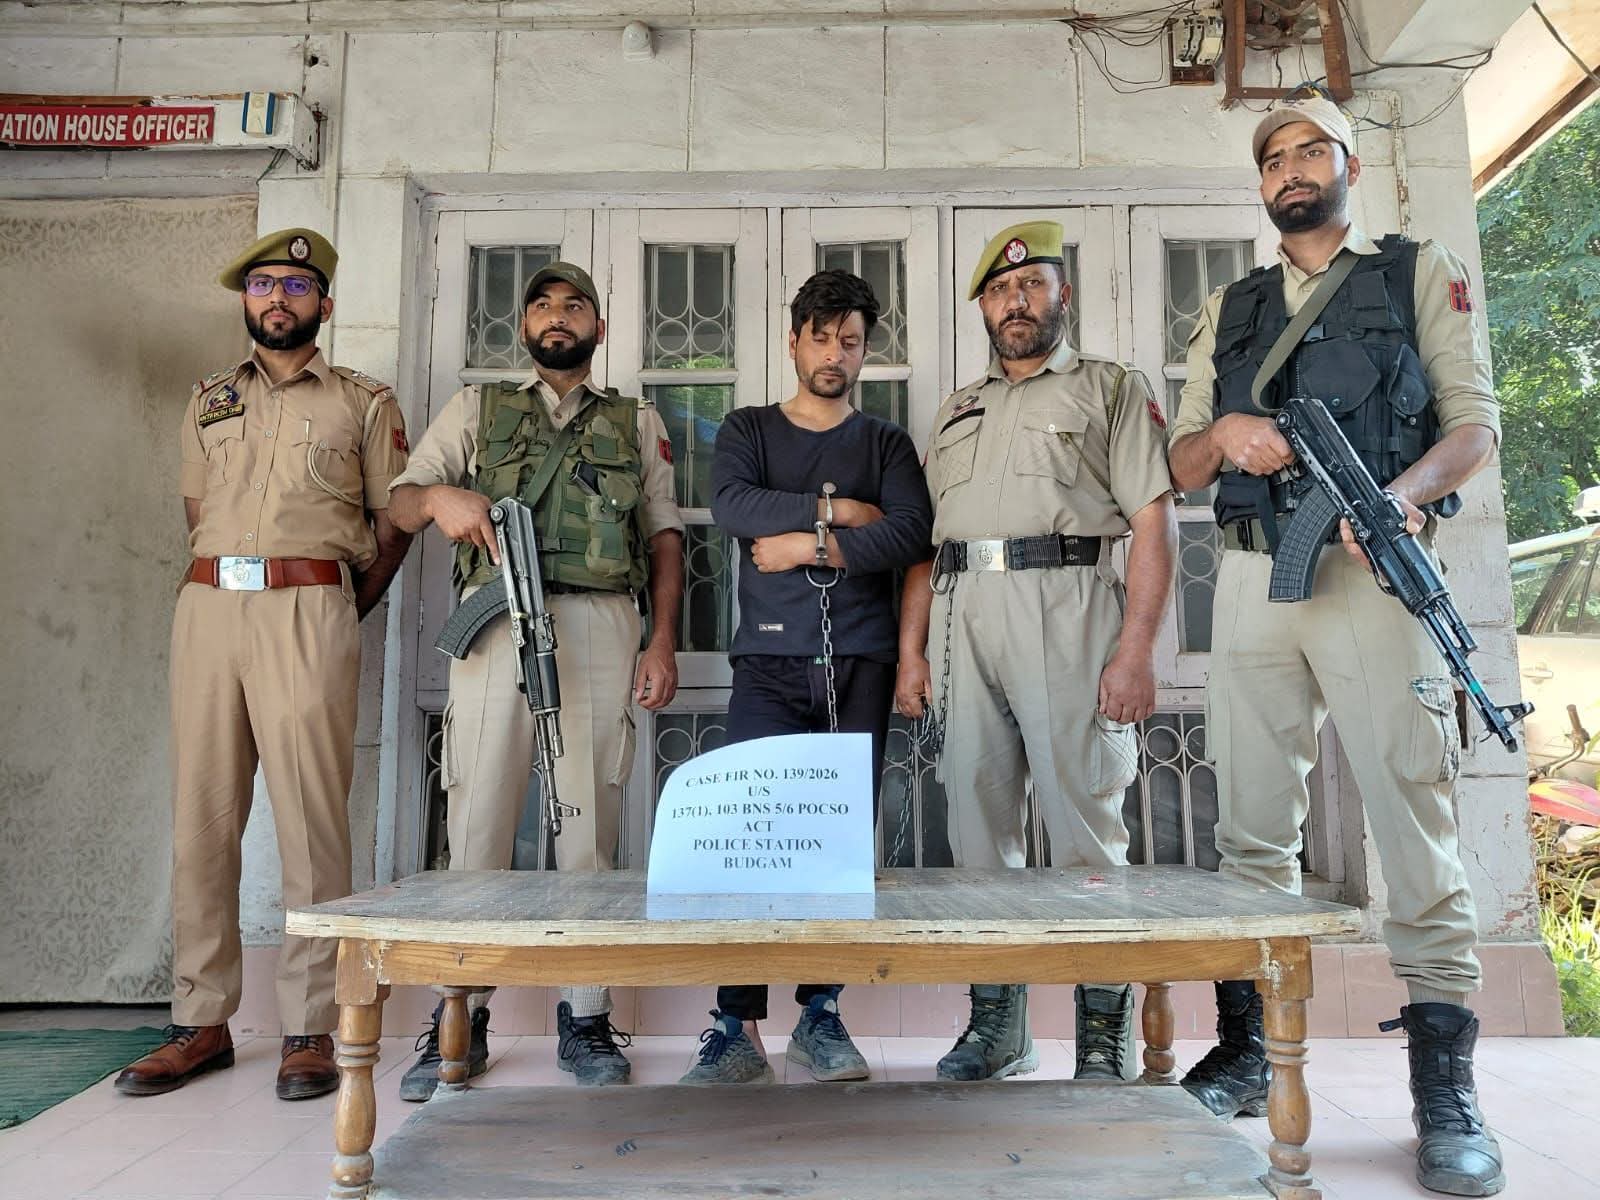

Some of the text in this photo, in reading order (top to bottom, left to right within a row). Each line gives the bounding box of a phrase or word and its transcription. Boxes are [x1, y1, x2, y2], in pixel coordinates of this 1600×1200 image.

[64, 114, 128, 141] HOUSE
[132, 114, 209, 141] OFFICER
[686, 767, 839, 788] CASE FIR NO. 139/2026
[748, 785, 771, 797] U/S
[717, 803, 738, 815] 103
[743, 803, 771, 815] BNS
[775, 802, 794, 815] 5/6
[798, 802, 849, 815] POCSO
[743, 820, 774, 833] ACT
[693, 838, 823, 851] POLICE STATION
[724, 856, 792, 869] BUDGAM
